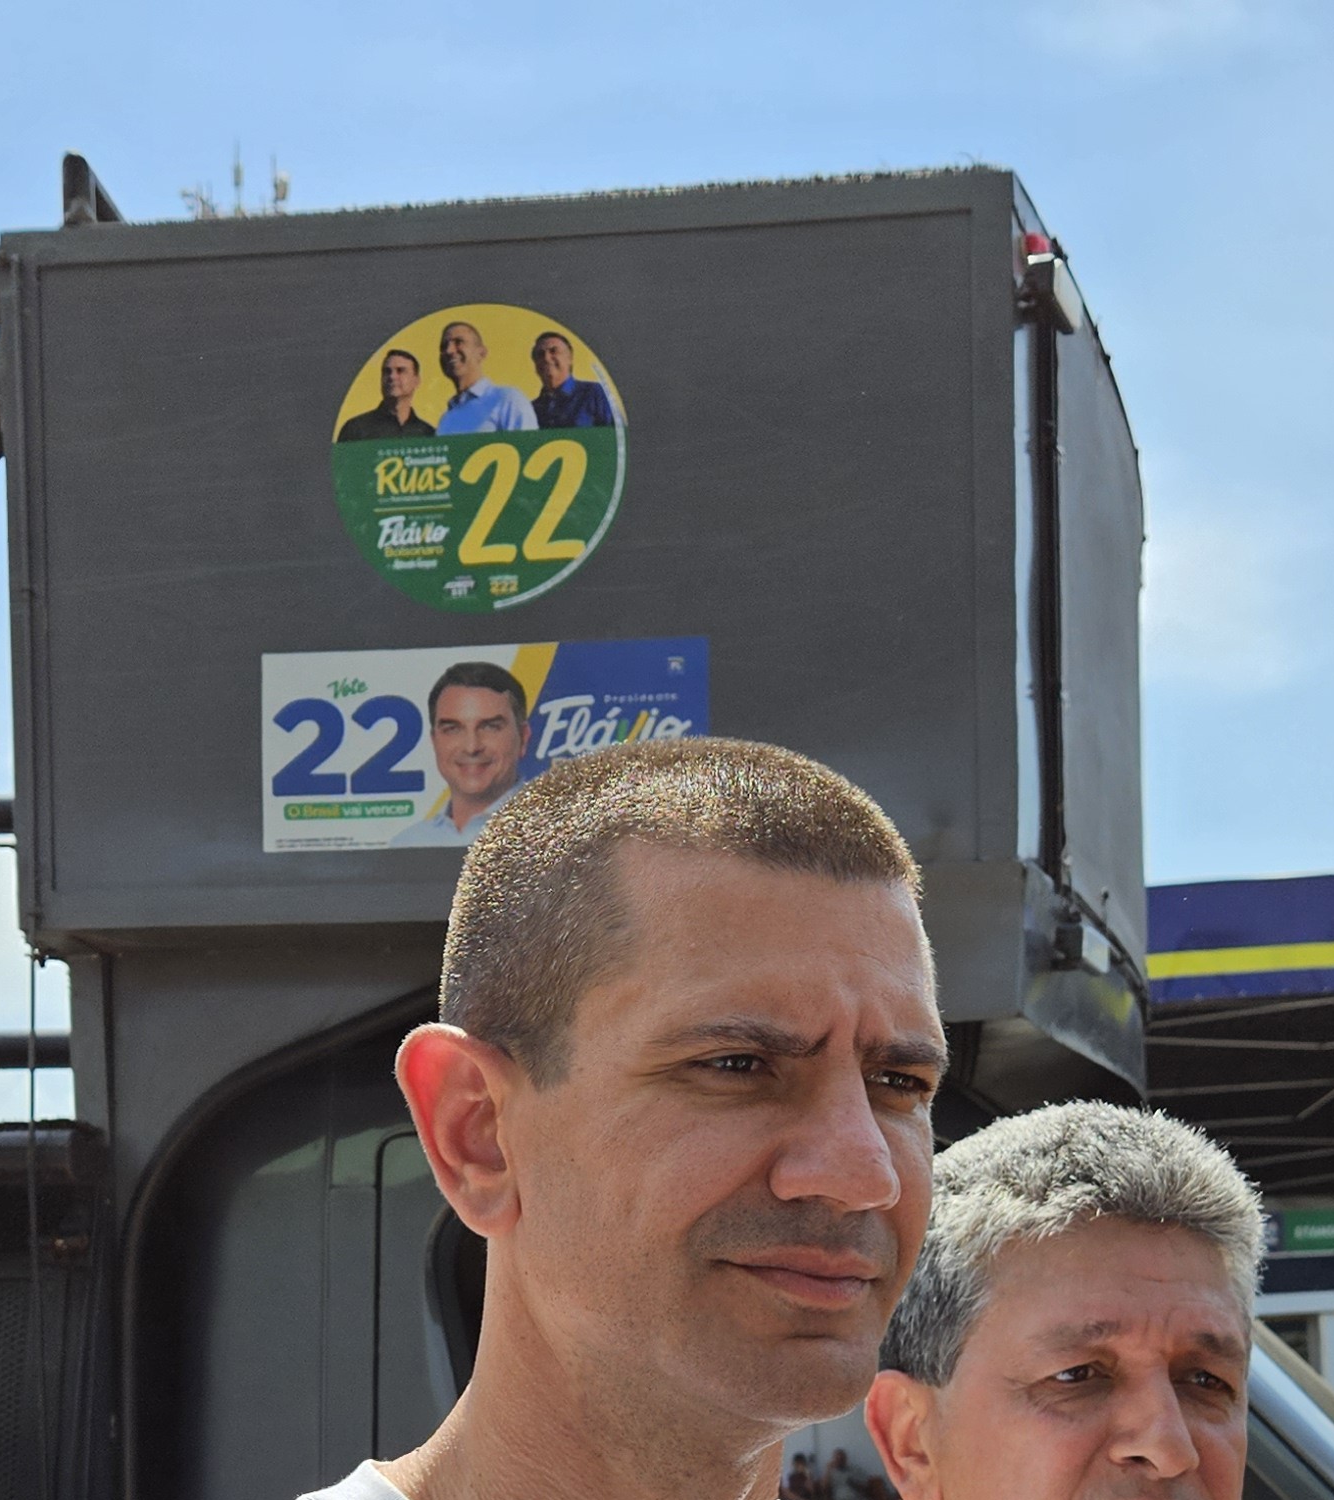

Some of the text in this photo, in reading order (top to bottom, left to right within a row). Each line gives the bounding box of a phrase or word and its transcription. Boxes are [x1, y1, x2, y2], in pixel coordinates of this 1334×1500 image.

[375, 457, 451, 495] Ruas
[458, 439, 588, 565] 22
[377, 515, 450, 549] Flávio
[327, 677, 368, 699] Vote
[272, 694, 425, 797] 22
[536, 694, 692, 760] Flávio
[343, 805, 362, 817] vai
[365, 803, 410, 816] vencer
